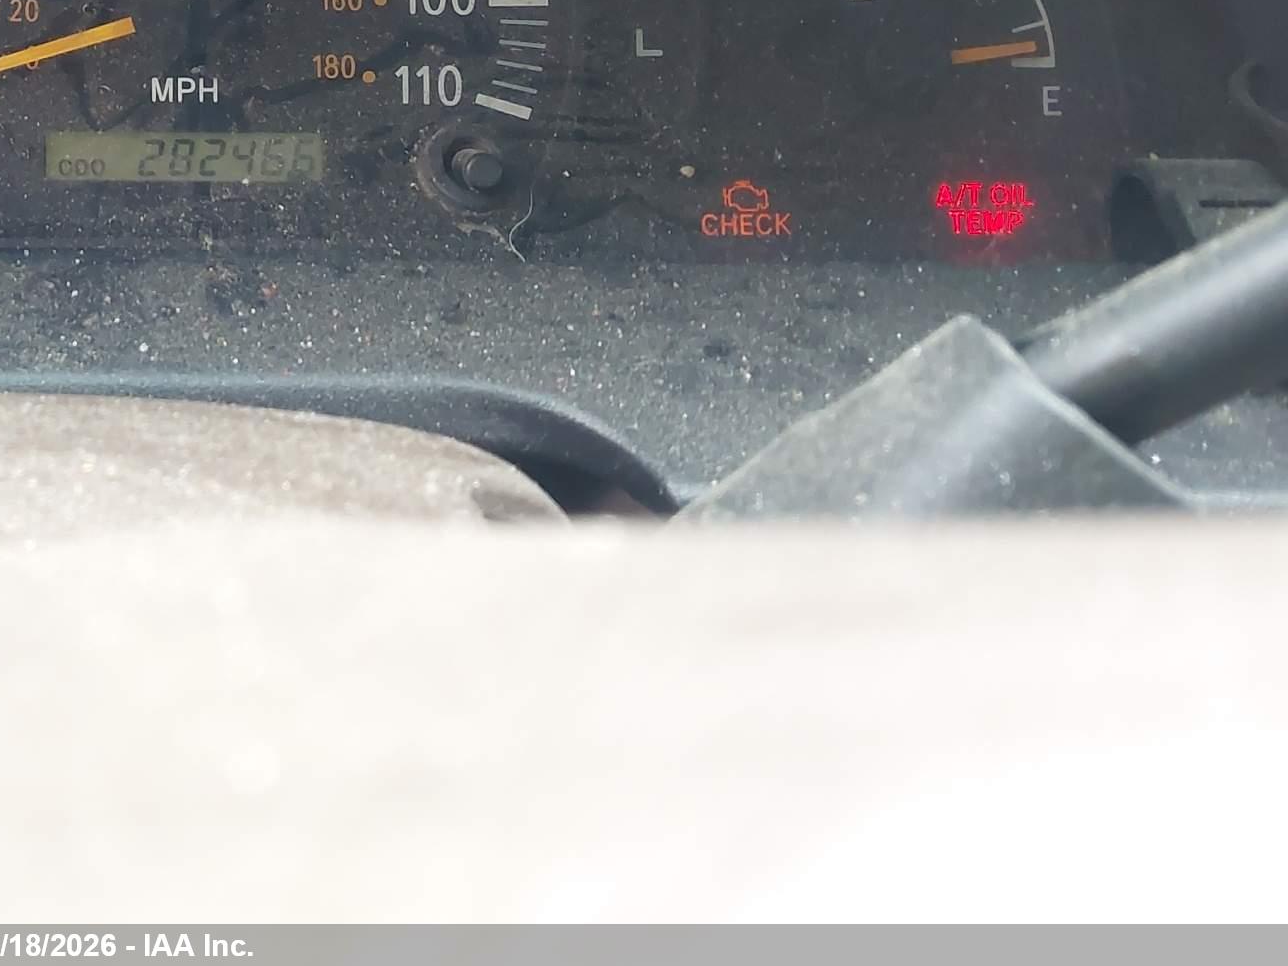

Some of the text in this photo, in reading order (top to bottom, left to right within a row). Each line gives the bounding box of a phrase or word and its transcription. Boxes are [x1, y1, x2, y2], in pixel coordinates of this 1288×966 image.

[636, 29, 663, 57] L
[312, 54, 355, 79] 180
[151, 77, 219, 104] MPH
[394, 65, 462, 107] 110
[1042, 86, 1062, 116] E
[936, 182, 1035, 207] A/T OIL
[701, 213, 792, 235] CHECK
[949, 210, 1024, 234] TEMP
